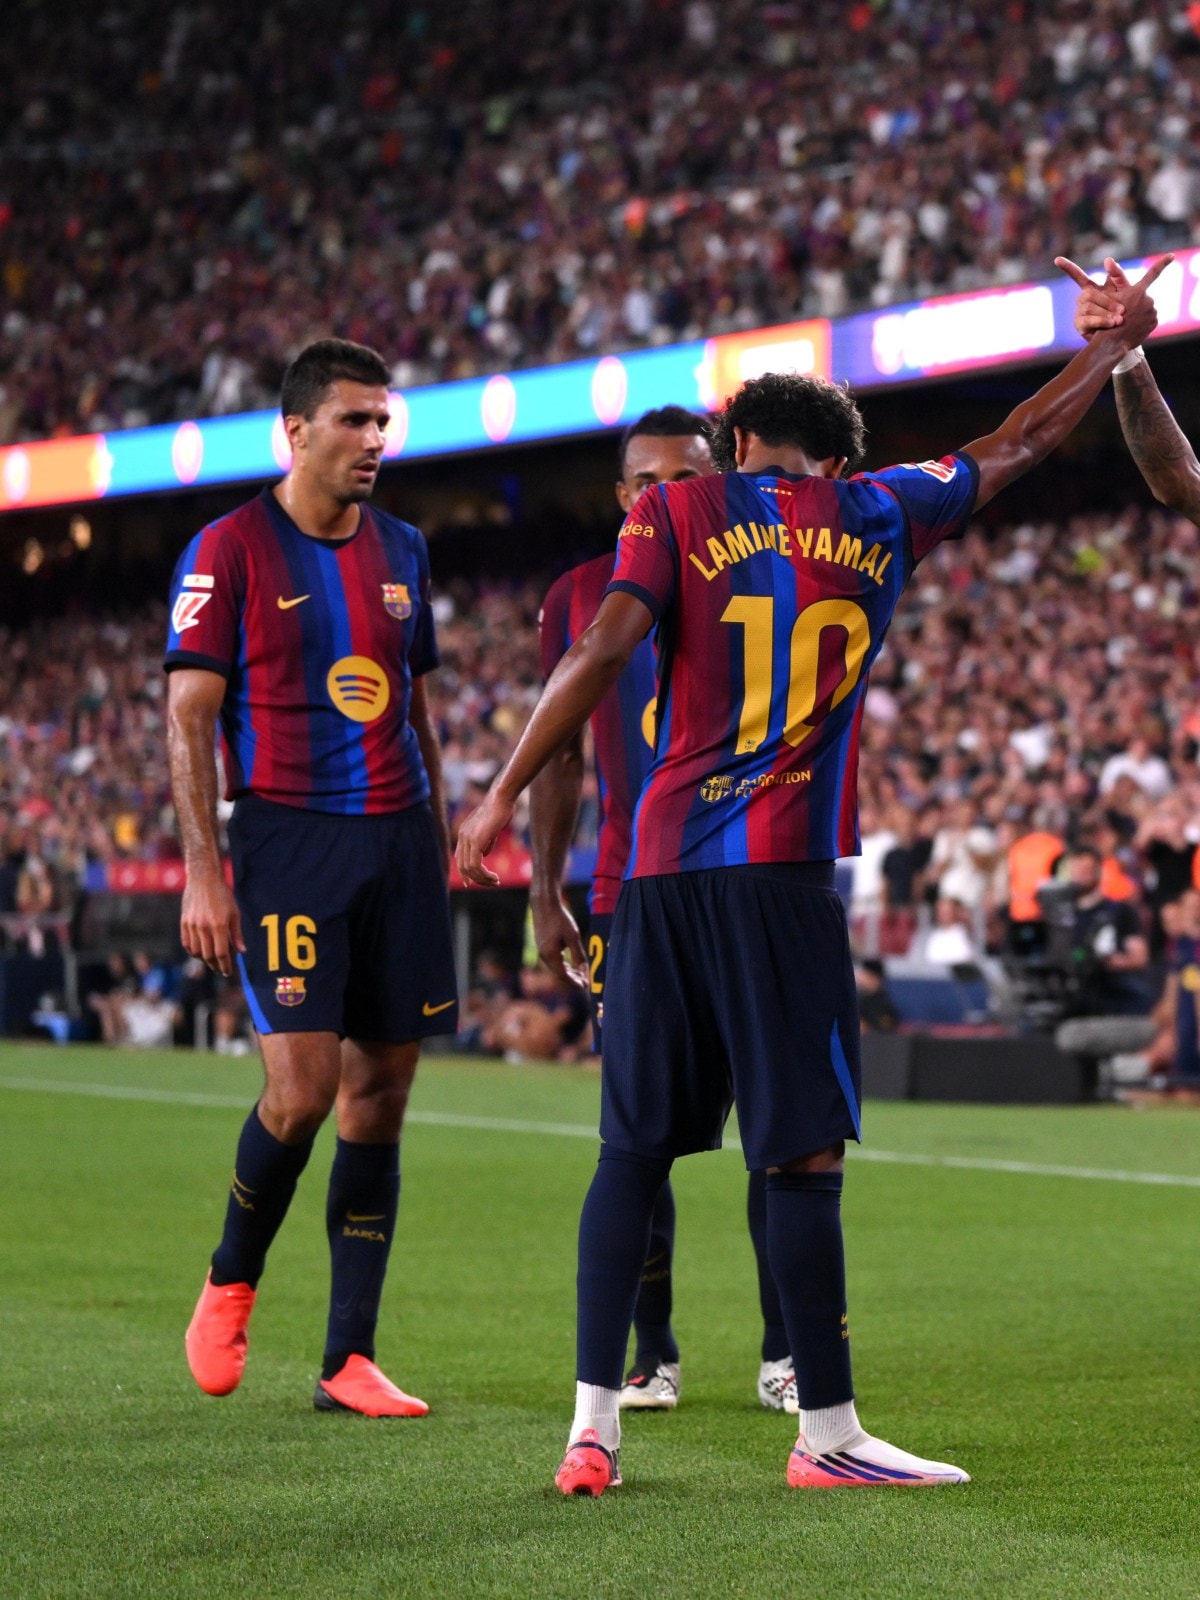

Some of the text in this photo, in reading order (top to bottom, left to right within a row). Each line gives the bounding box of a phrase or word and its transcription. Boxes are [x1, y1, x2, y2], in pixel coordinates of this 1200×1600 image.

[688, 521, 893, 586] LAMINE YAMAL
[720, 596, 871, 755] 10
[260, 914, 317, 971] 16
[588, 934, 604, 994] 2
[343, 1226, 385, 1243] BARÇA
